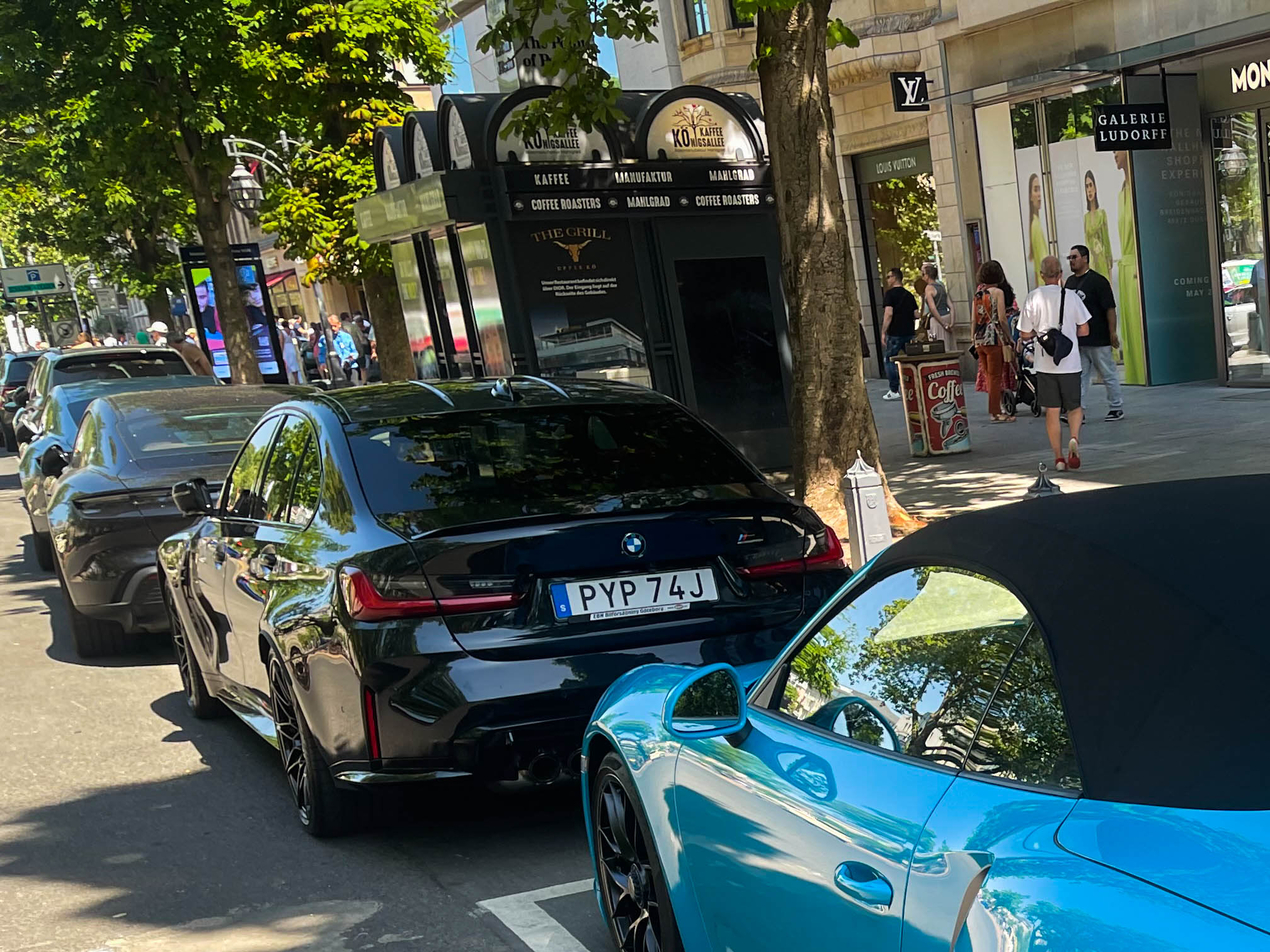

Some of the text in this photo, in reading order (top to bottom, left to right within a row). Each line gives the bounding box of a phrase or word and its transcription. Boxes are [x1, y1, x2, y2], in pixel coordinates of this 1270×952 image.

[1098, 112, 1166, 126] GALERIE
[700, 127, 724, 137] KAFFEE
[1100, 128, 1168, 142] LUDORFF
[876, 157, 916, 174] LOUIS VUITTON
[534, 169, 755, 186] KAFFEE MANUFAKTUR MAHLGRAD
[531, 194, 760, 211] COFFEE ROASTERS MAHLGRAD COFFEE ROASTERS
[530, 227, 611, 242] THE GRILL
[1174, 276, 1209, 285] COMING
[1186, 289, 1204, 297] MAY
[579, 572, 704, 611] PYP 74J
